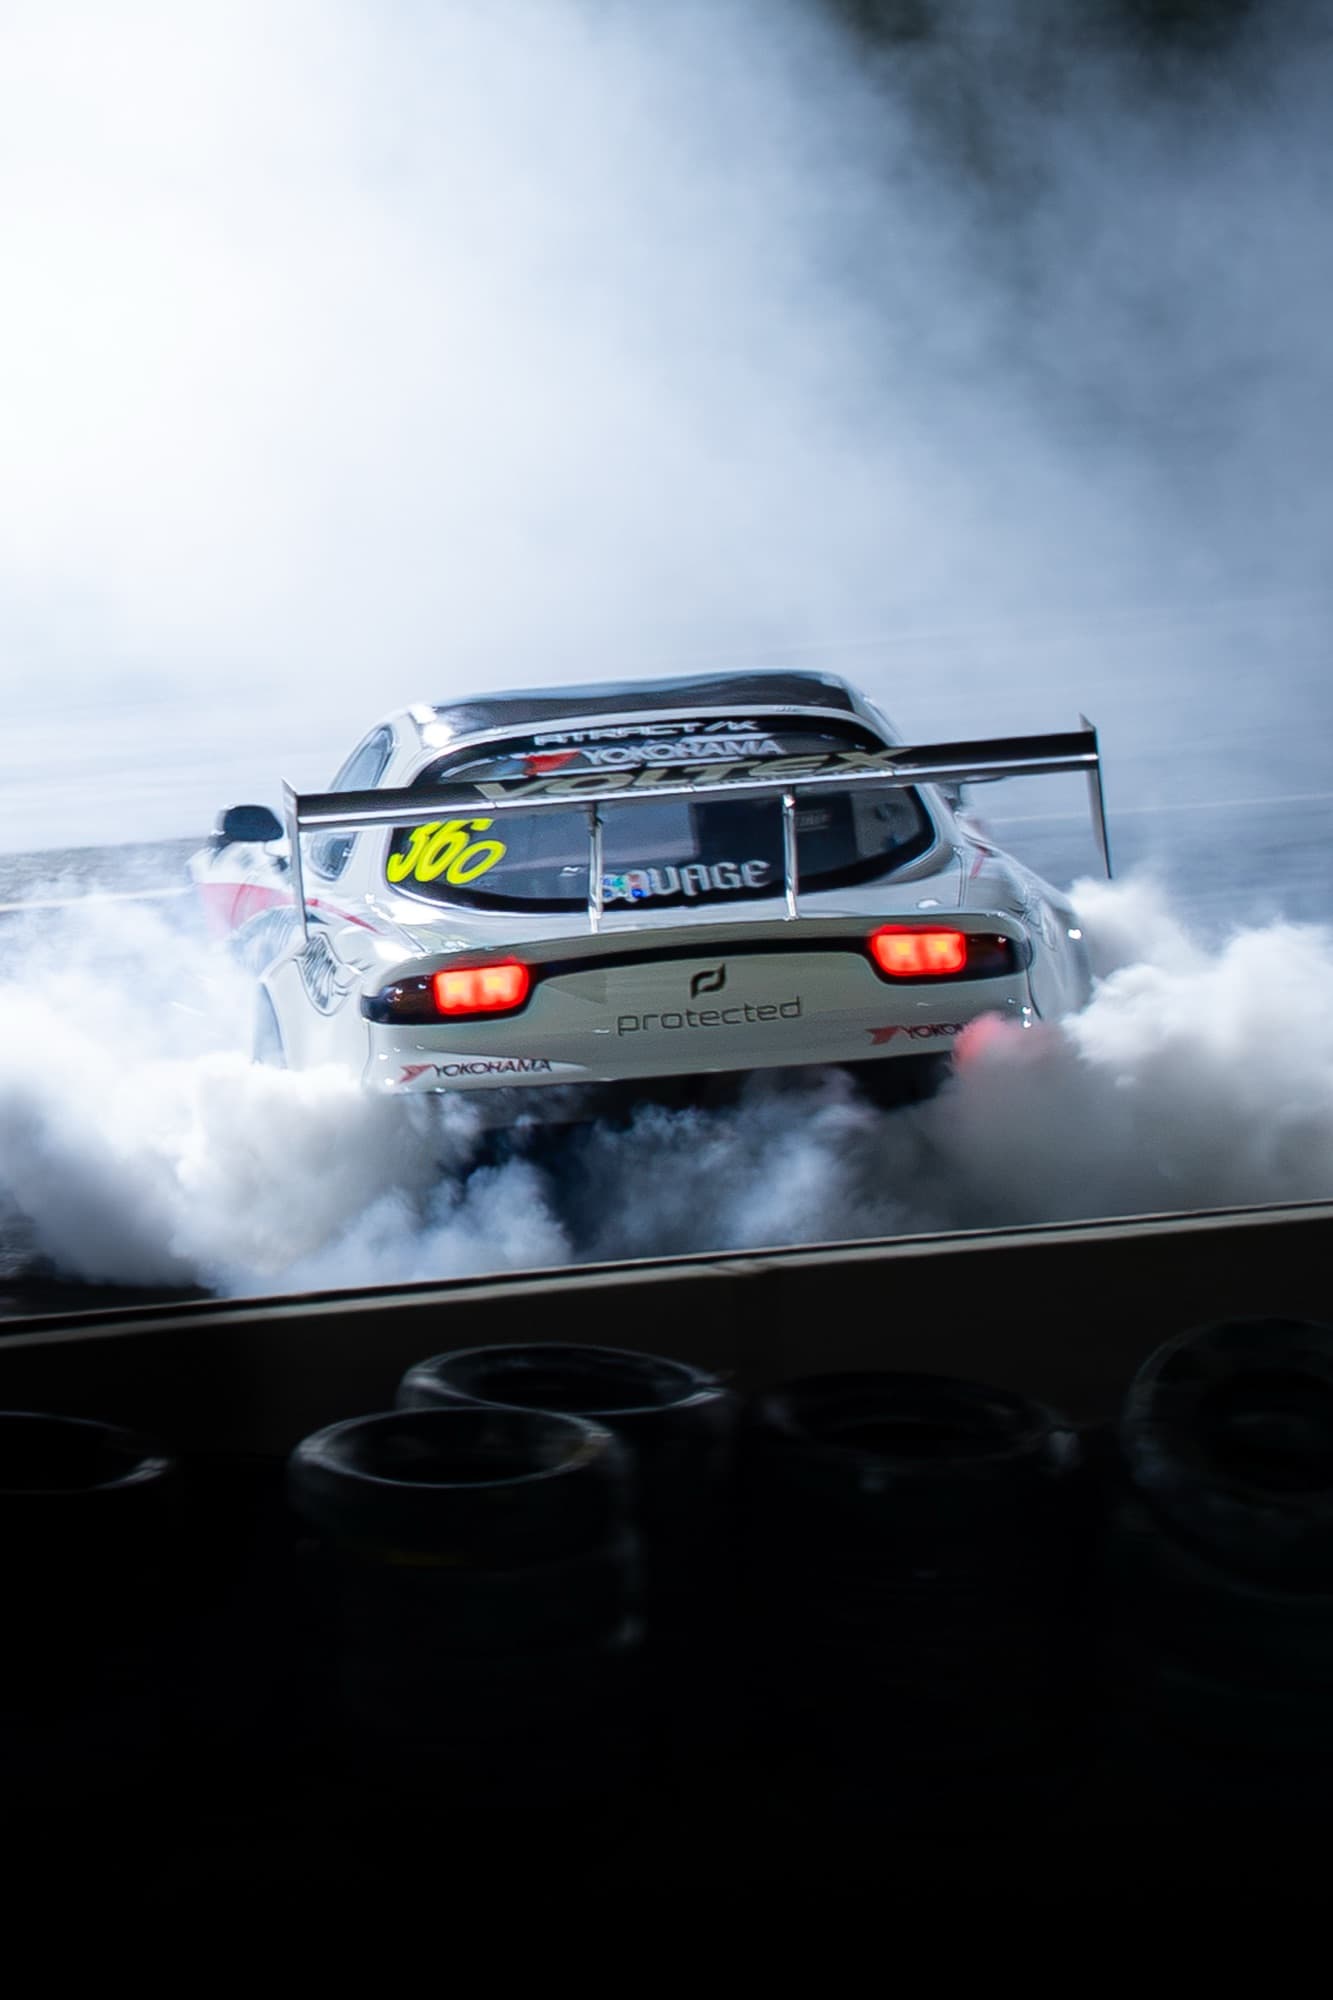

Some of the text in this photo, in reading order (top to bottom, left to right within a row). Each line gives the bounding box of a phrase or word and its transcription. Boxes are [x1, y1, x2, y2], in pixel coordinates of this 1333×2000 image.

[581, 740, 785, 765] YOKOHAMA
[475, 748, 911, 799] VOLTEX
[601, 859, 771, 904] SAVAGE
[617, 996, 803, 1036] protected
[431, 1058, 553, 1078] YOKOHAMA
